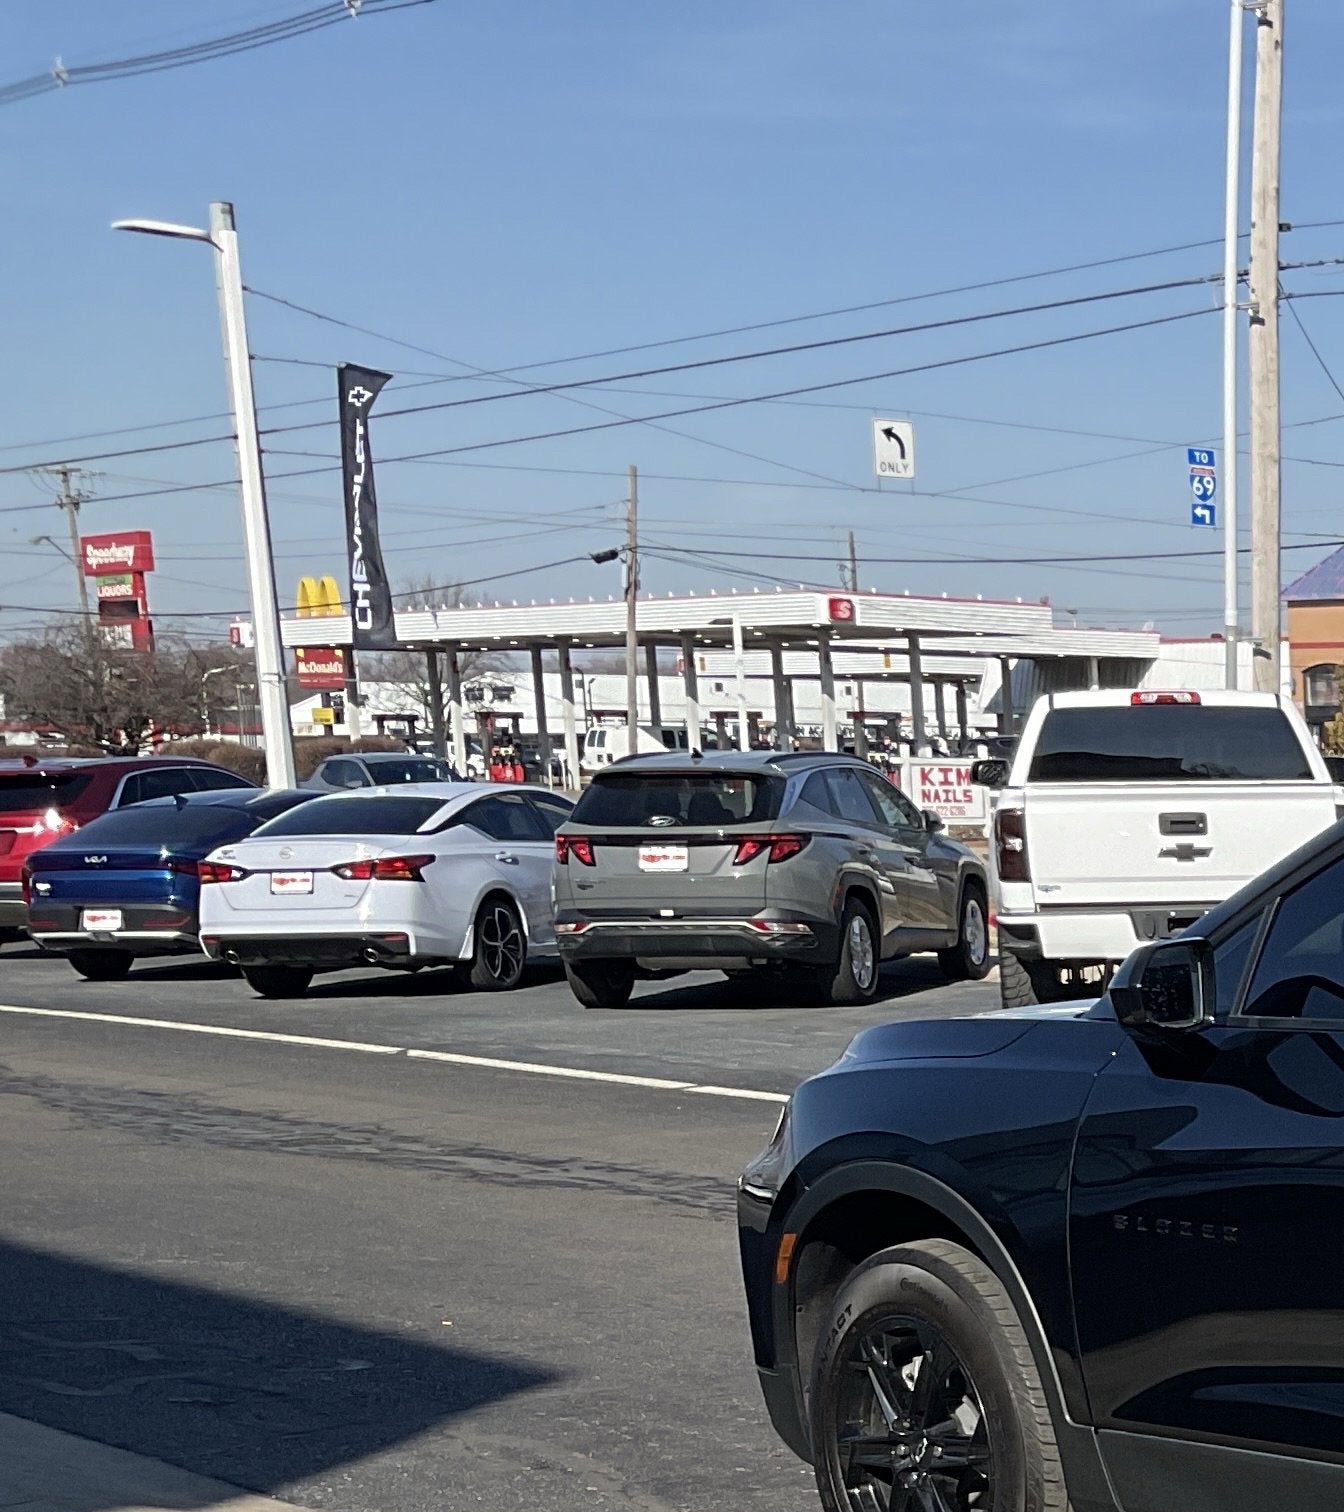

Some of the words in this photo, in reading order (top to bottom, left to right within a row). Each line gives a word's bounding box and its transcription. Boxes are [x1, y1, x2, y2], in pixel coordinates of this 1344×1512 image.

[1194, 451, 1208, 463] TO
[880, 461, 909, 474] ONLY
[1193, 476, 1214, 496] 69
[86, 542, 135, 569] Speedway
[836, 601, 851, 619] S
[298, 661, 343, 674] McDonald's
[920, 767, 970, 786] KIM
[921, 789, 973, 803] NAILS
